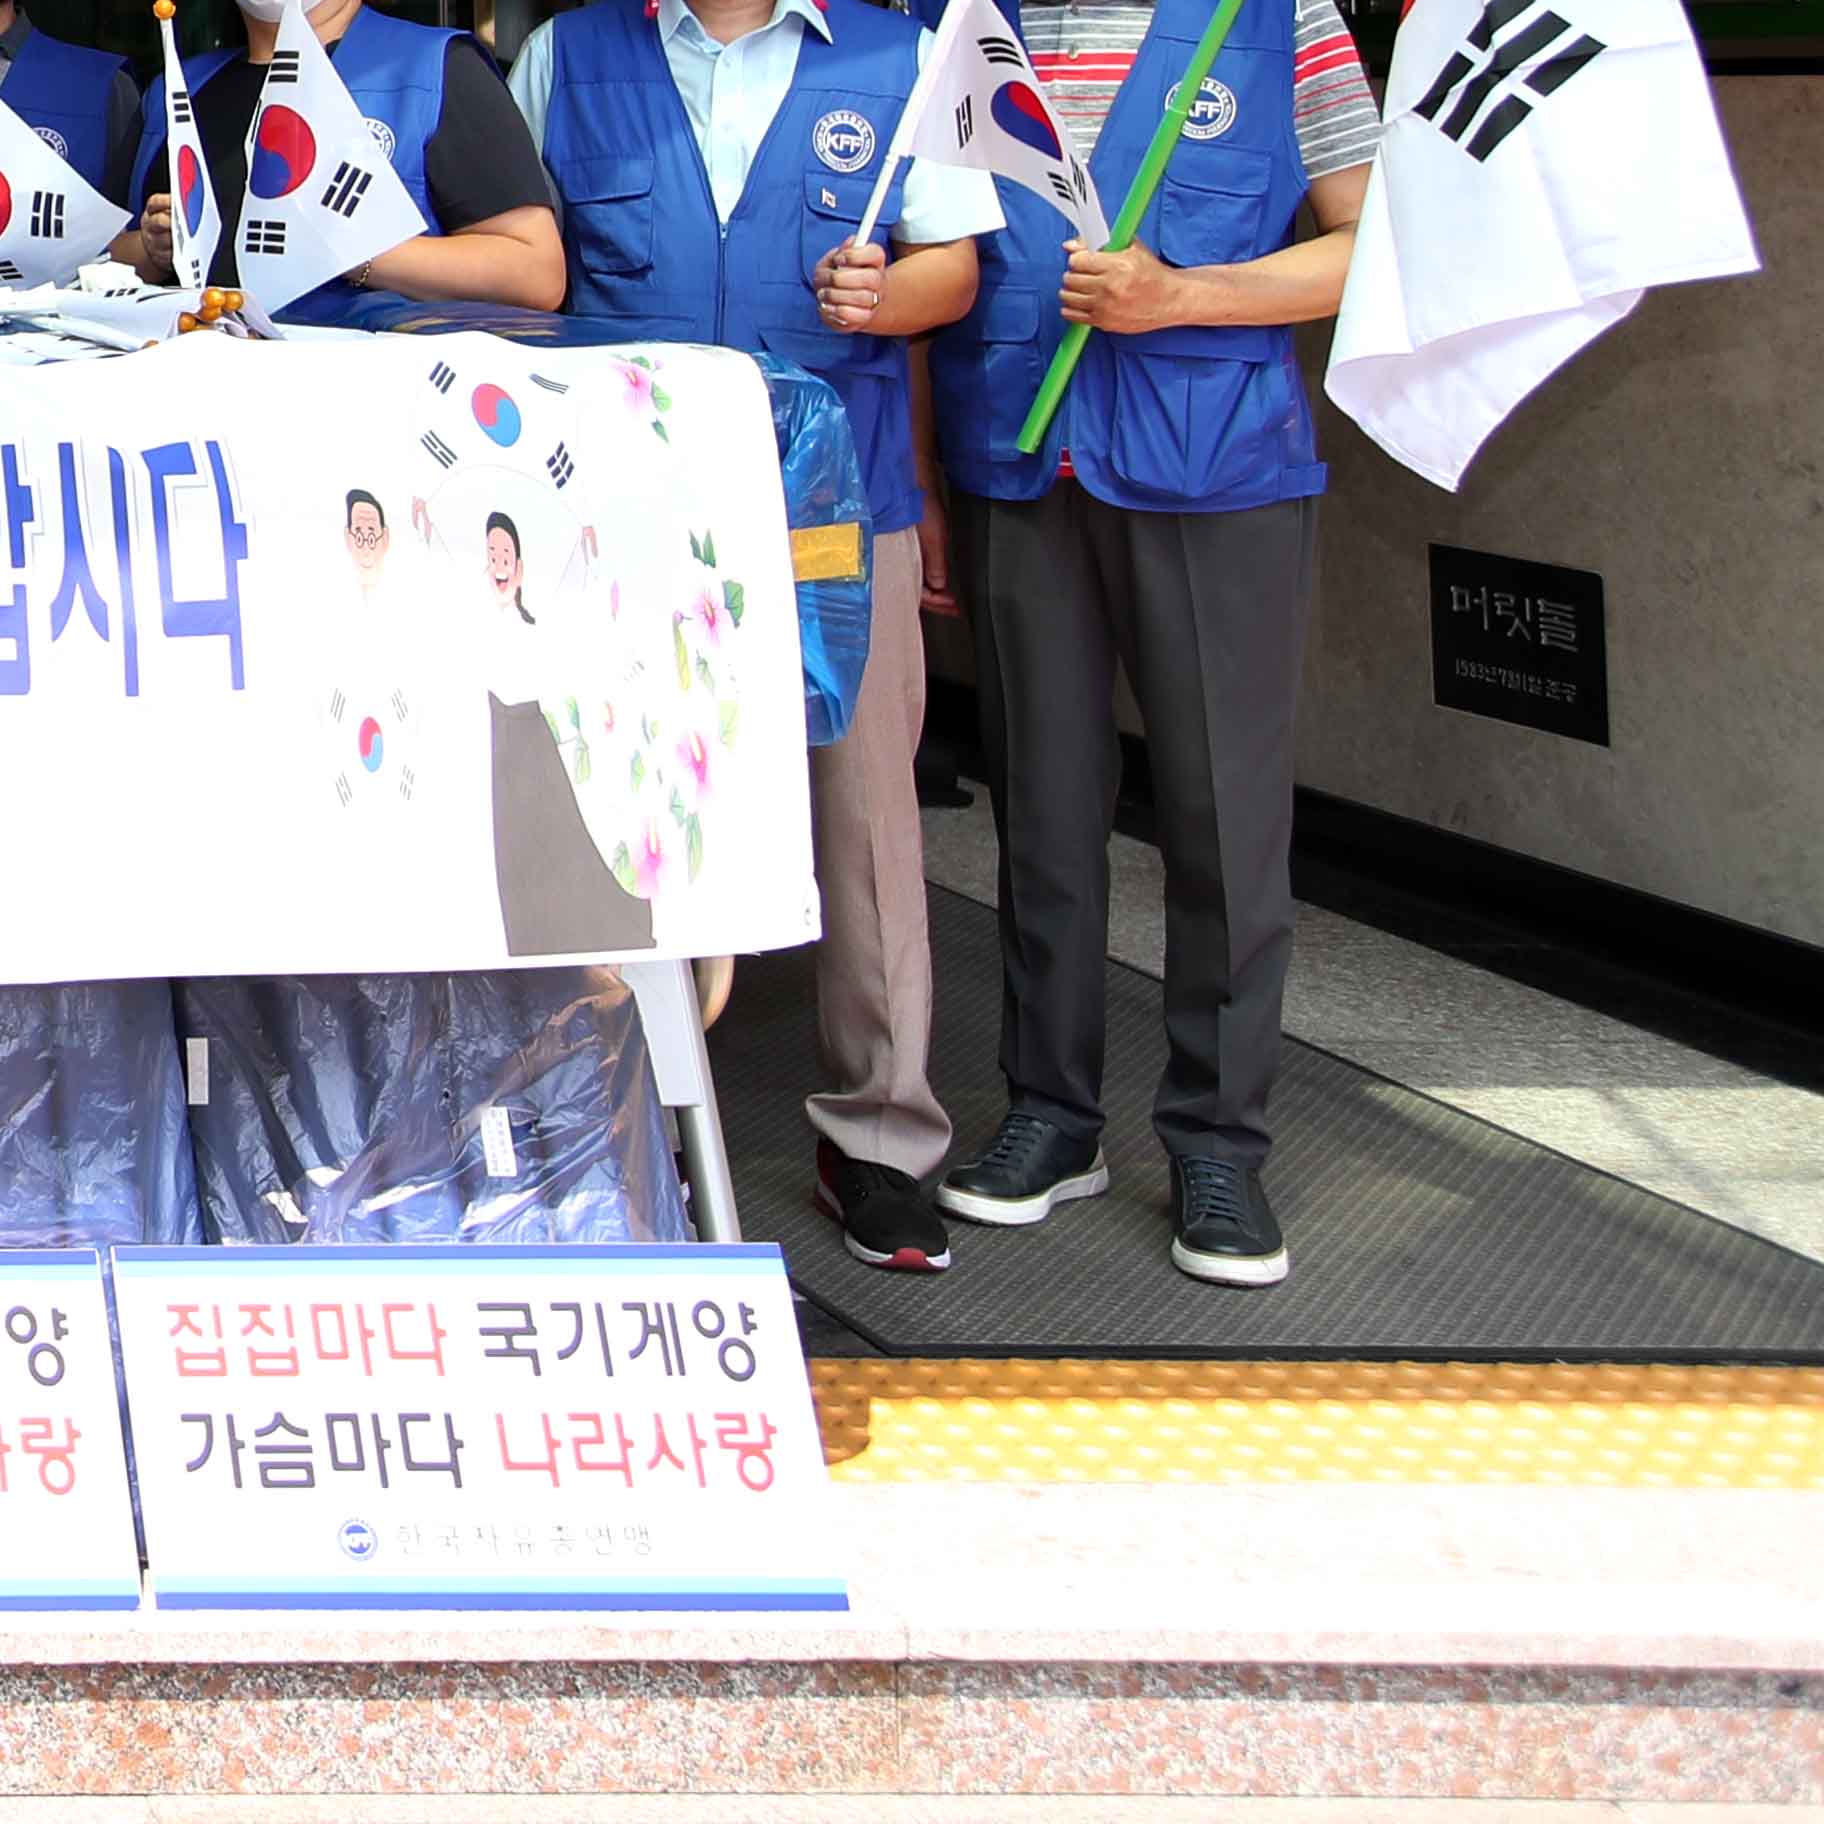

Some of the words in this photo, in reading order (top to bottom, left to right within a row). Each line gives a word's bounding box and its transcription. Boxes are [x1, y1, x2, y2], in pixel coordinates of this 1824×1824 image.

[826, 132, 864, 153] KFF
[1450, 585, 1579, 653] 머릿돌
[168, 1304, 446, 1376] 집집마다
[477, 1300, 758, 1382] 국기게양
[181, 1412, 464, 1488] 가슴마다
[496, 1413, 777, 1492] 나라사랑
